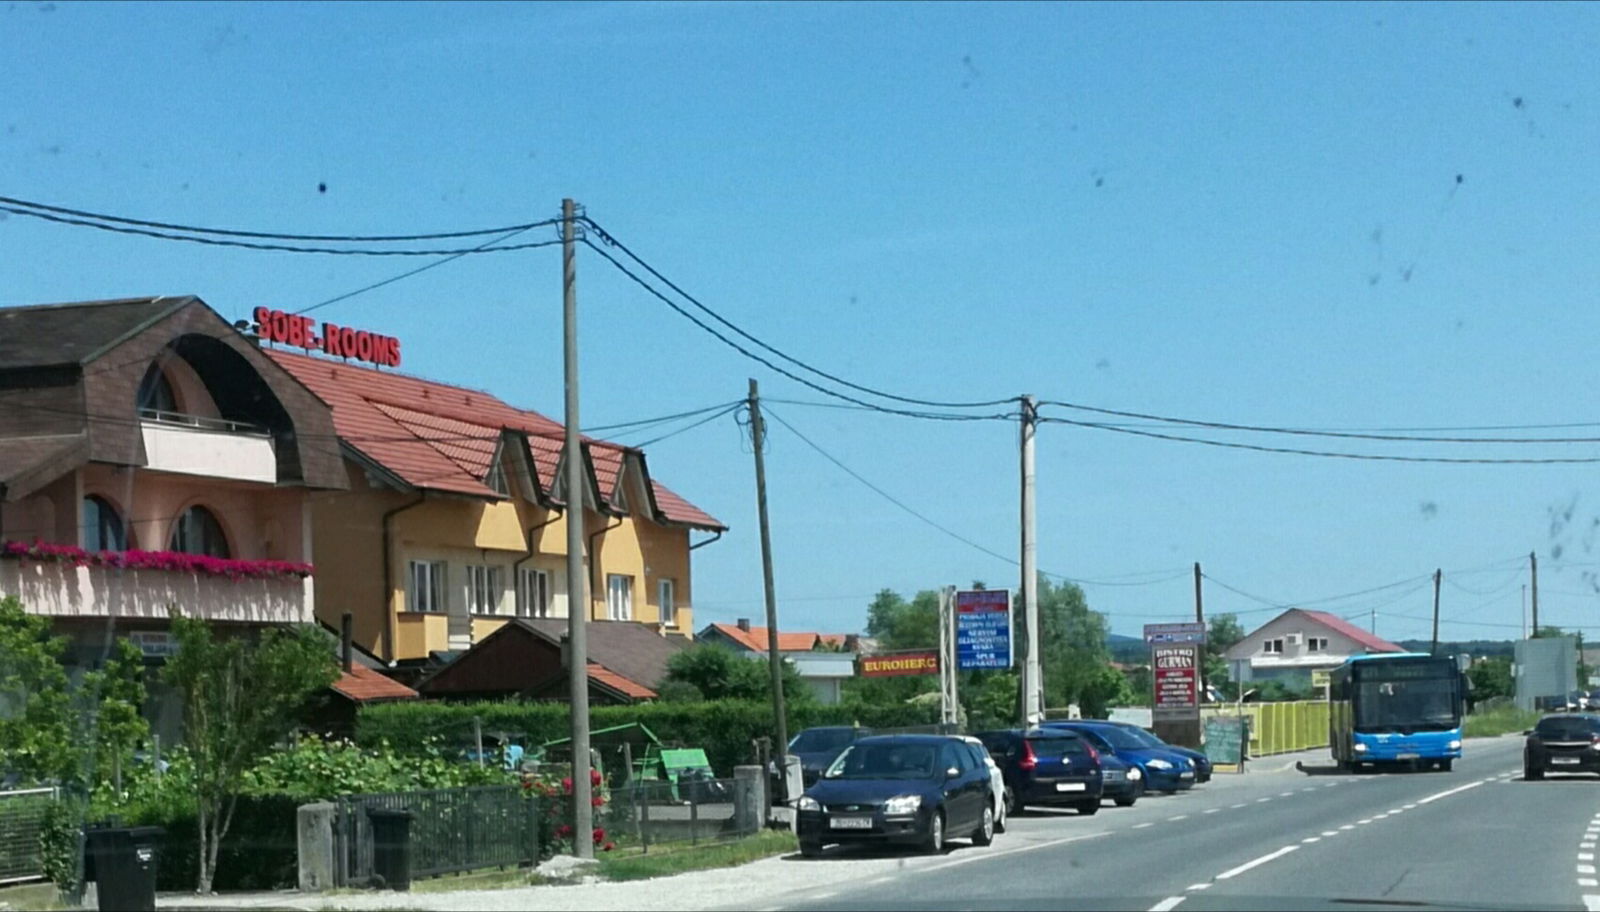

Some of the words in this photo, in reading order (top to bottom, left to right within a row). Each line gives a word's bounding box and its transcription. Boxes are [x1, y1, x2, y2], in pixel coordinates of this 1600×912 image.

[254, 306, 317, 350] SOBE
[322, 322, 401, 367] ROOMS
[1156, 649, 1193, 658] BISTRO
[864, 657, 936, 672] EUROHERC
